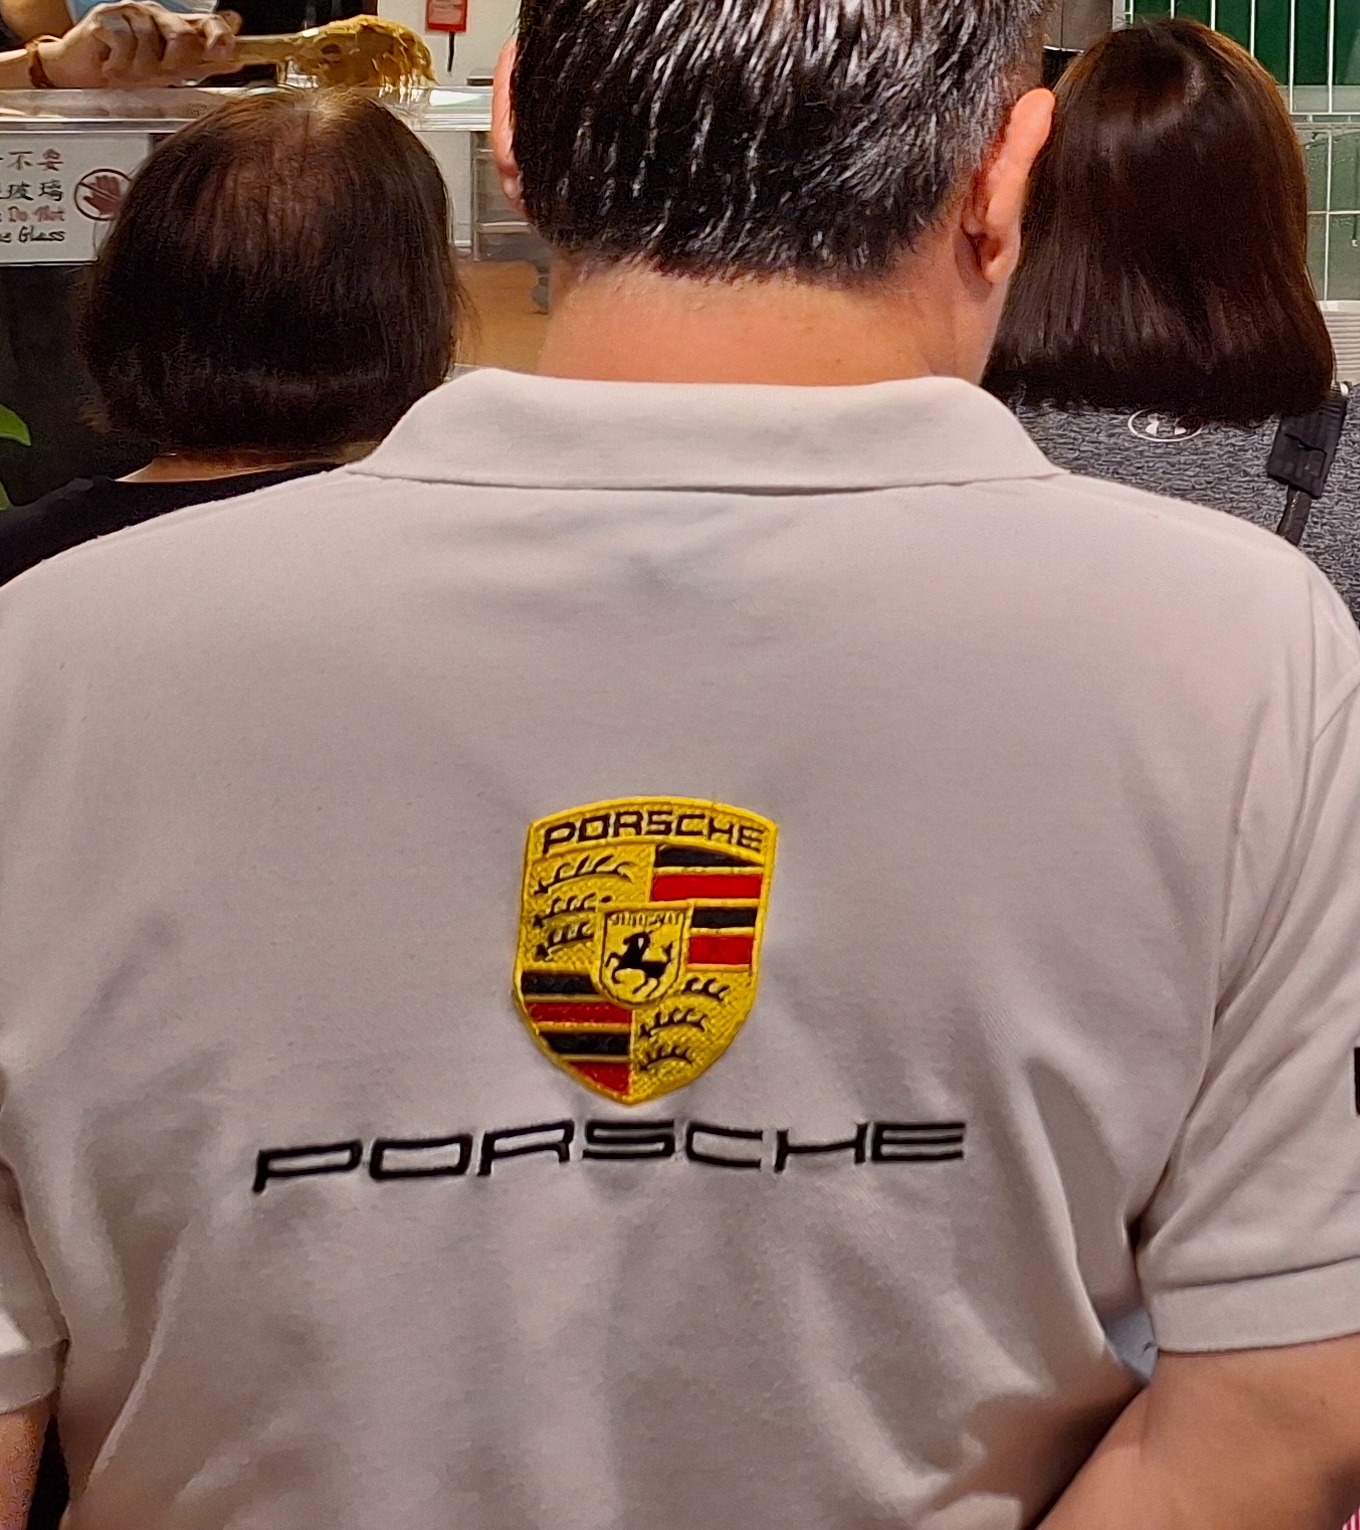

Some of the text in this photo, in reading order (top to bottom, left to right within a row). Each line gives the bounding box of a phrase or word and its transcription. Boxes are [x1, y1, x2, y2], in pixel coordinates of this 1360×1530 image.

[18, 225, 66, 243] Glass
[541, 807, 765, 856] PORSCHE
[252, 1117, 967, 1194] PORSCHE
